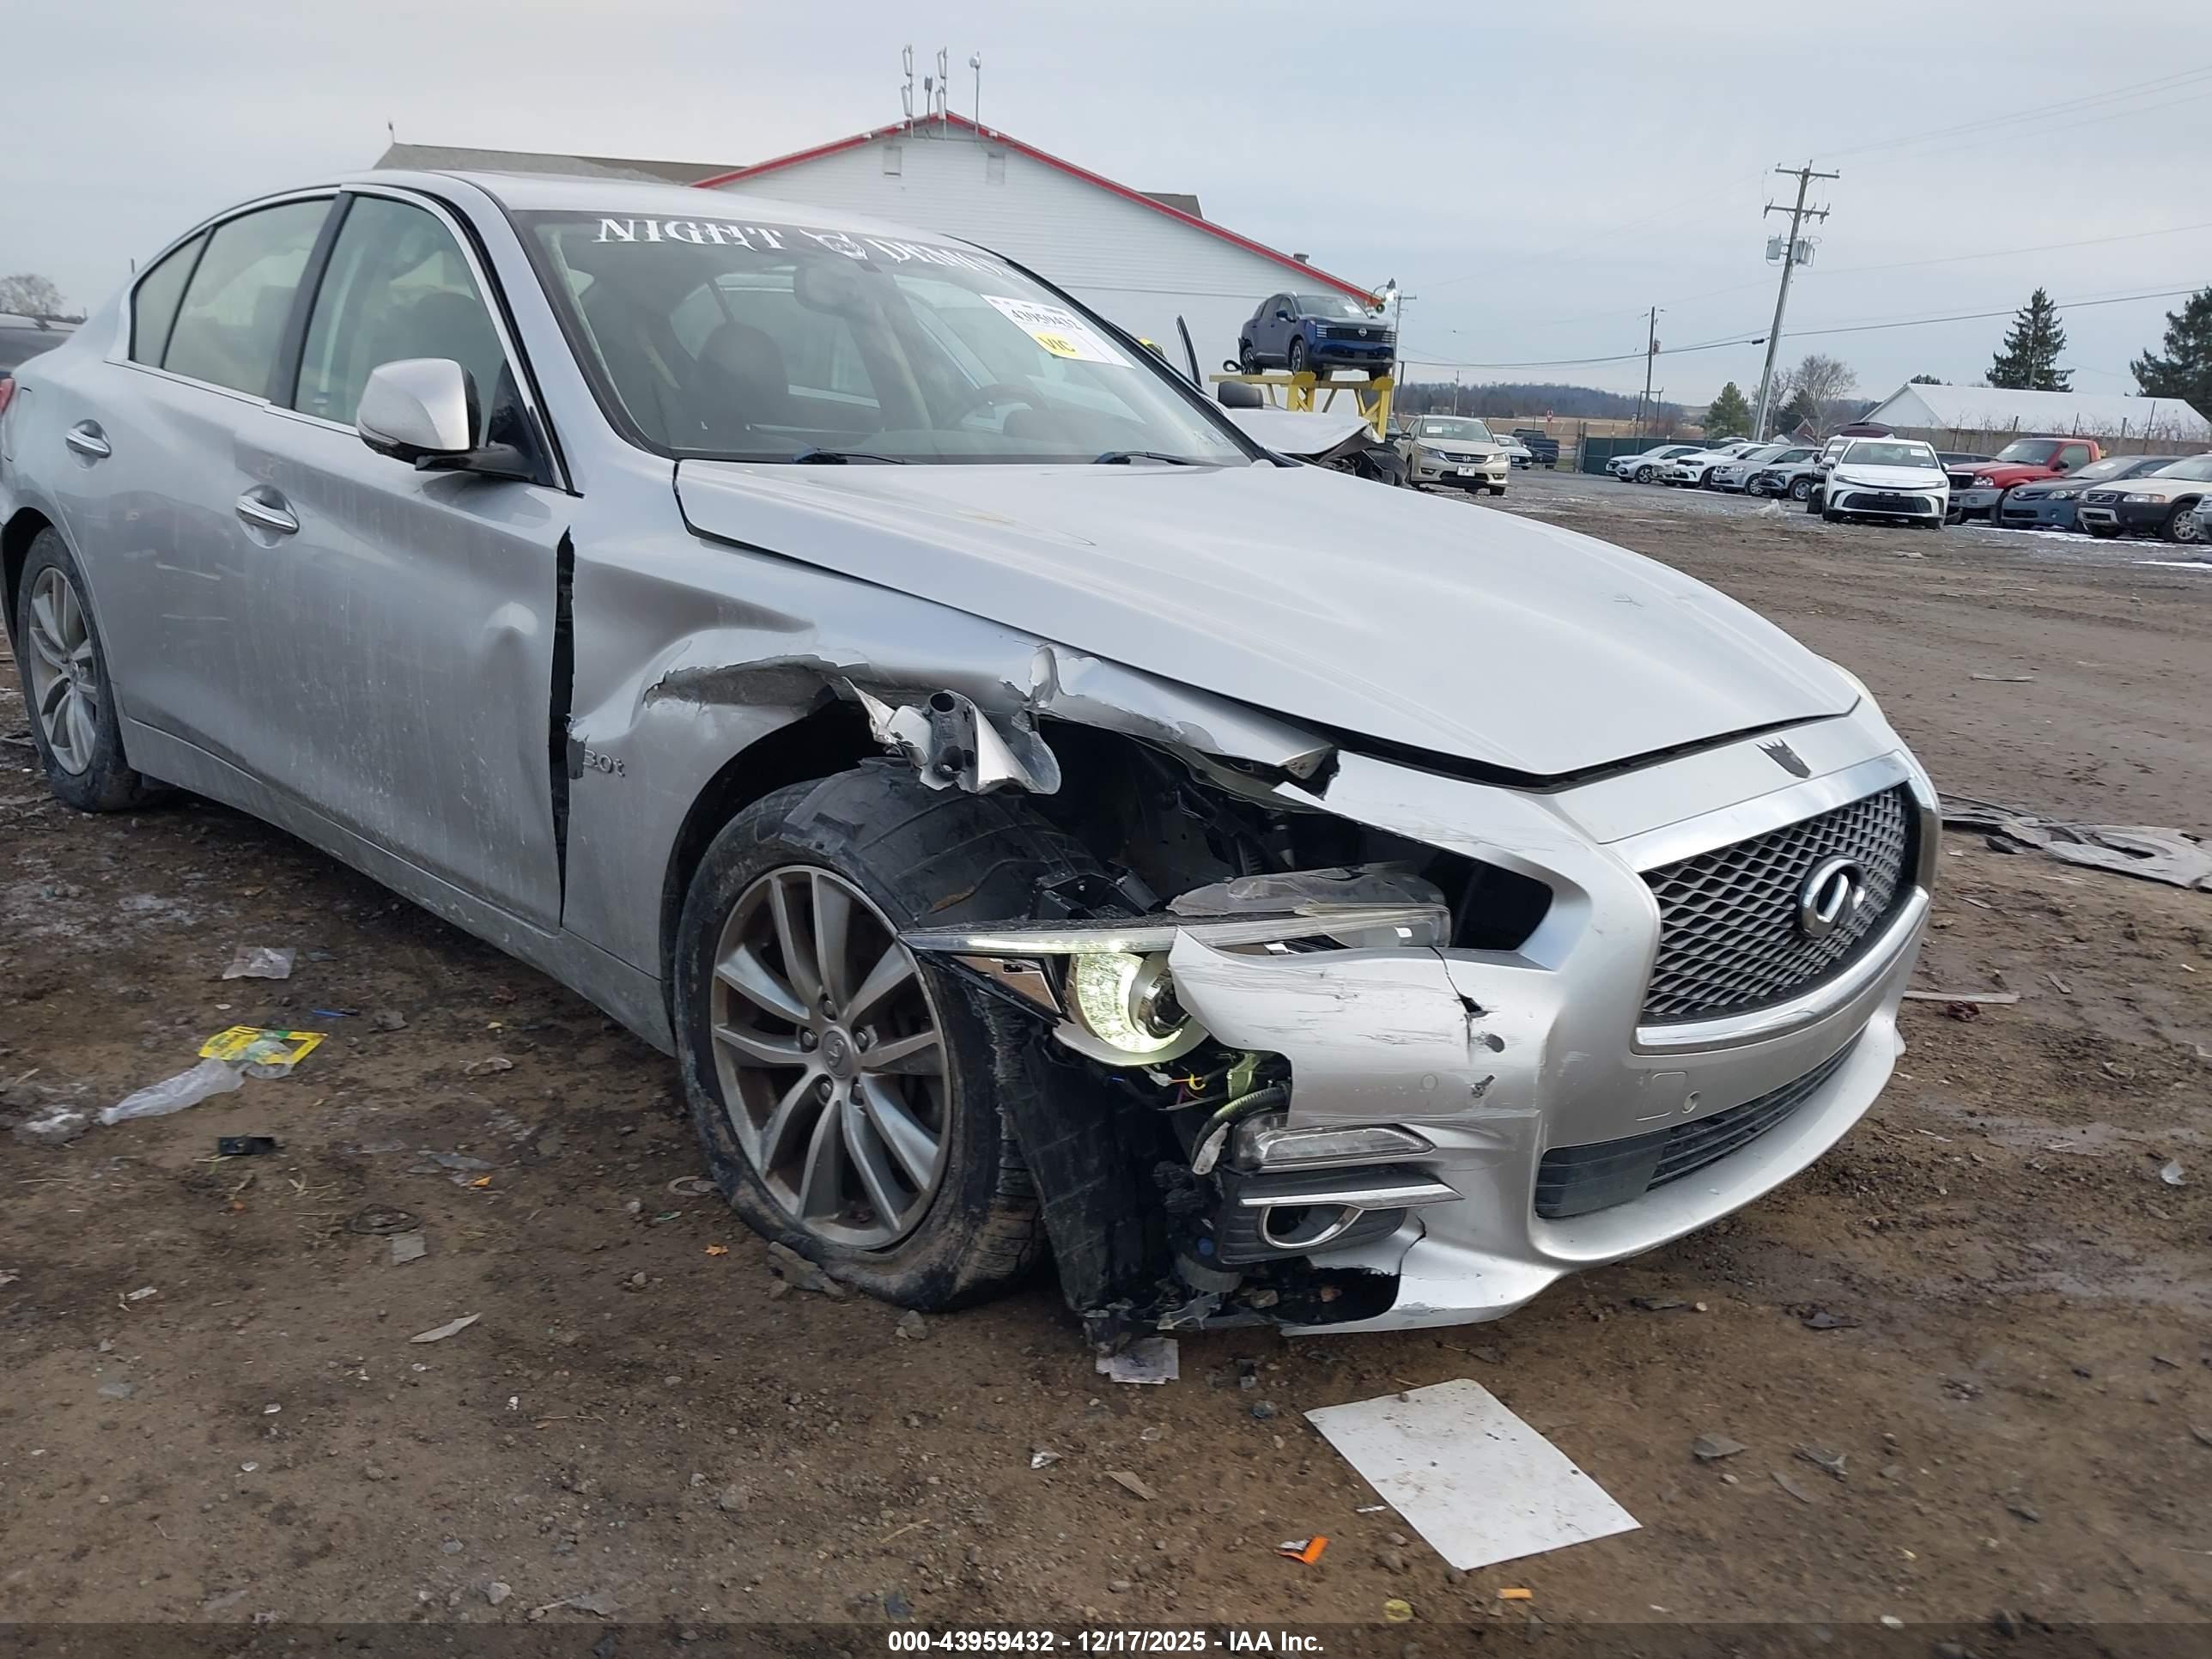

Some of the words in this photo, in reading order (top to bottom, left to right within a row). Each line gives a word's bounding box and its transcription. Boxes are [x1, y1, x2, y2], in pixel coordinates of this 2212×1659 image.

[592, 217, 787, 252] NIGHT
[1011, 309, 1084, 331] 43959432
[1037, 336, 1076, 353] VIC
